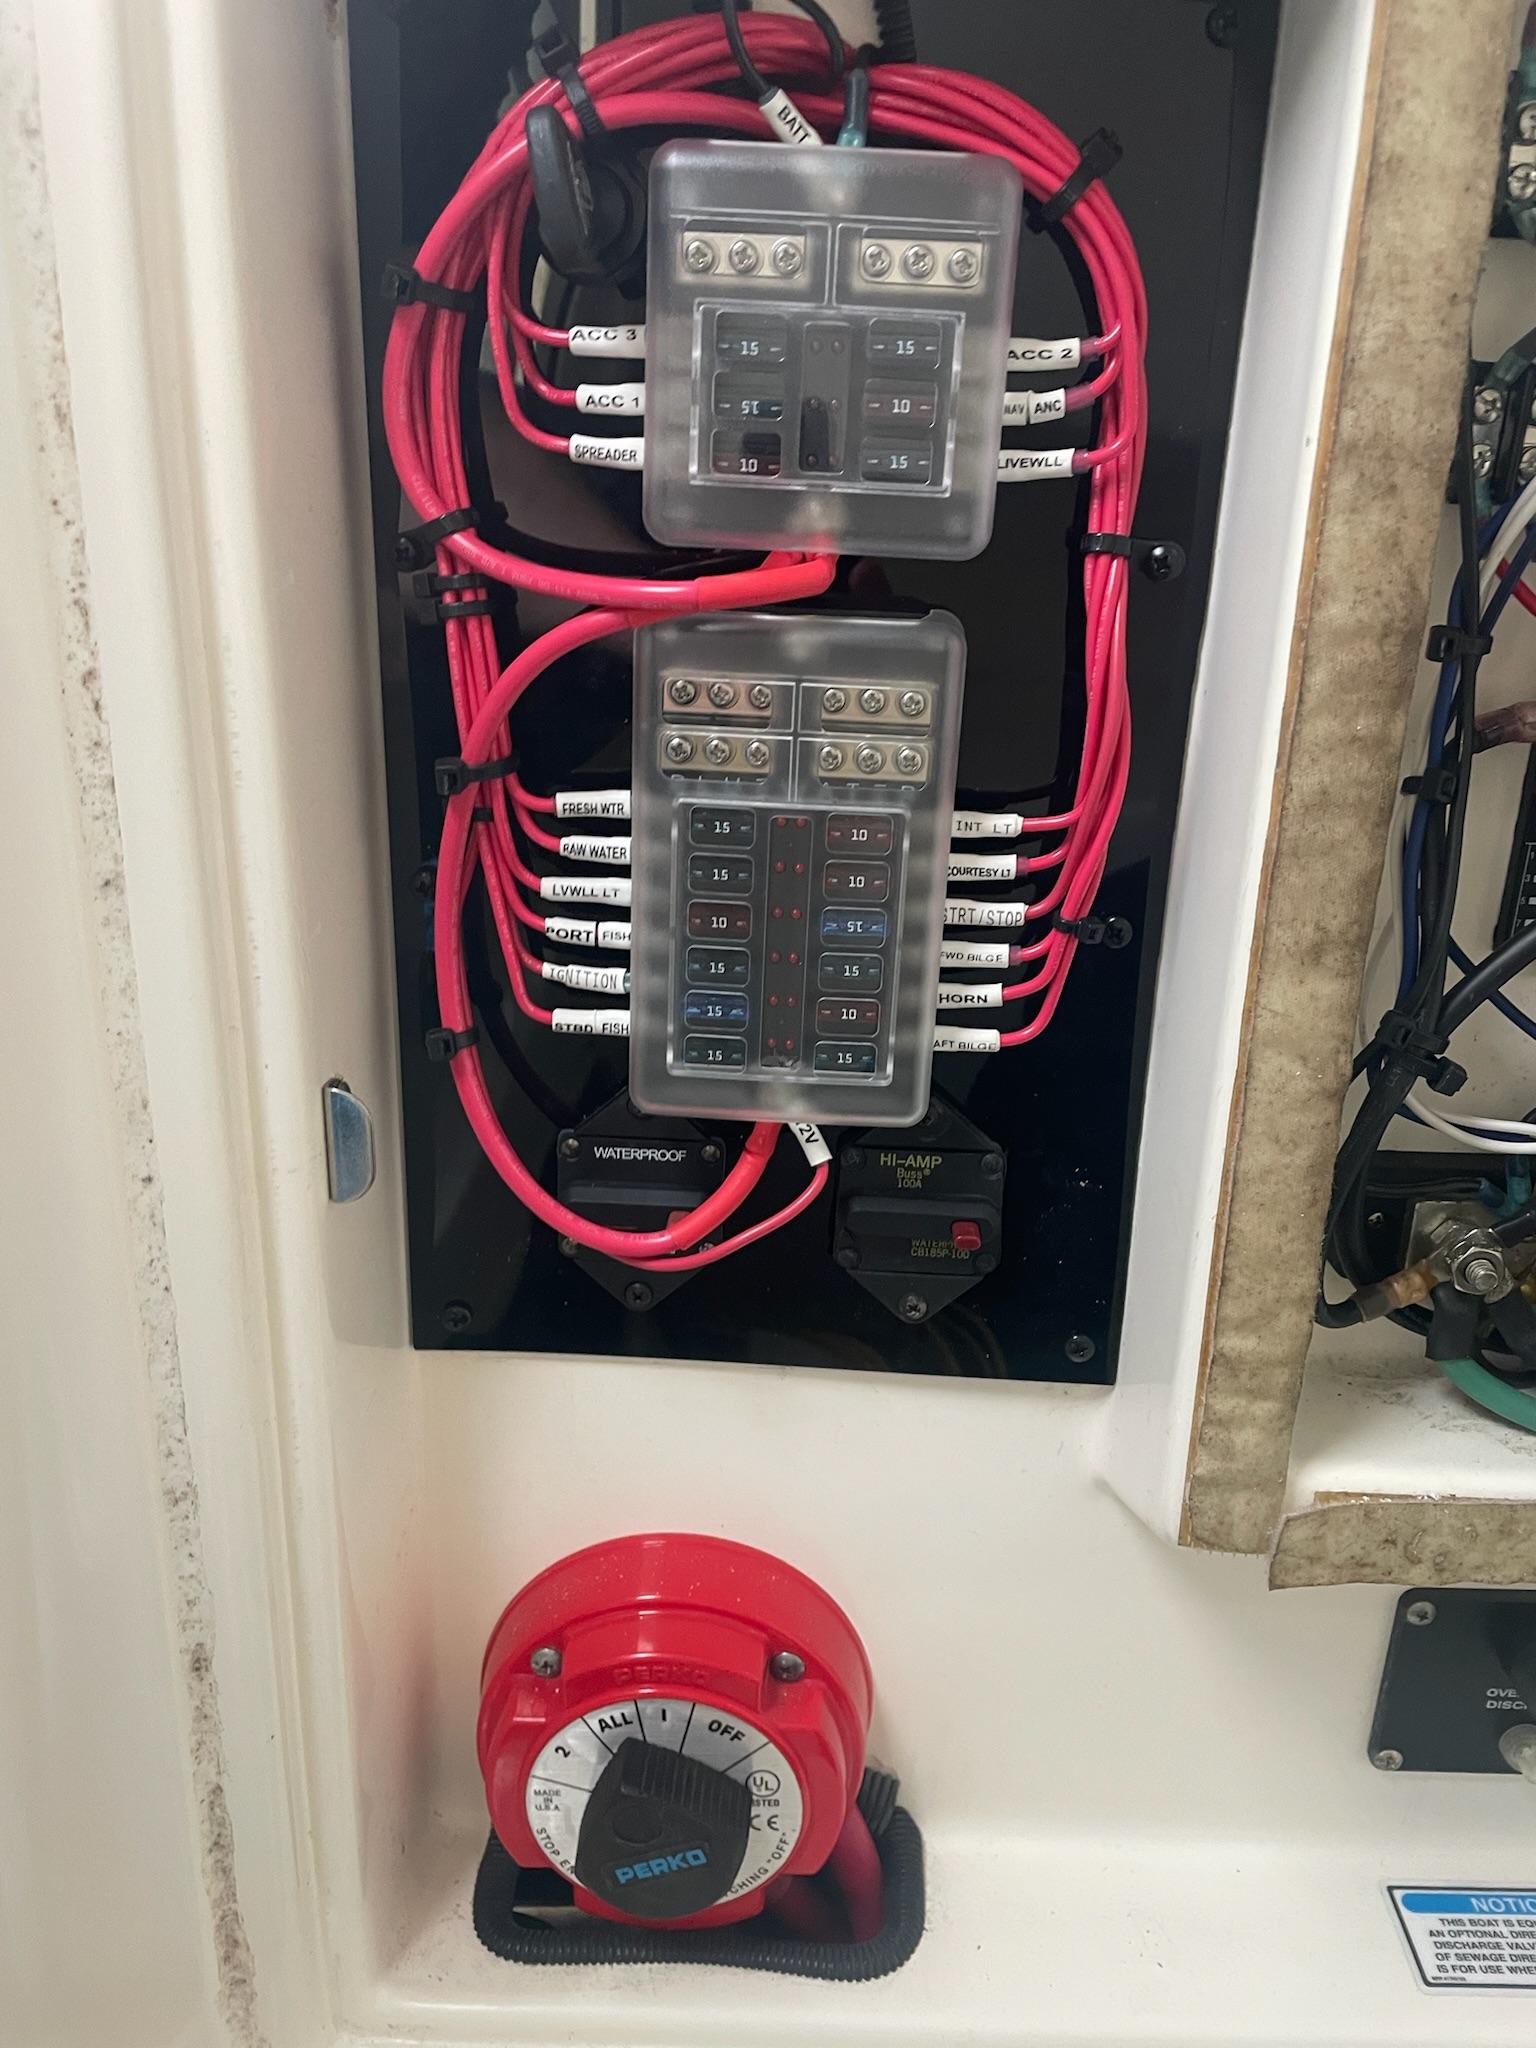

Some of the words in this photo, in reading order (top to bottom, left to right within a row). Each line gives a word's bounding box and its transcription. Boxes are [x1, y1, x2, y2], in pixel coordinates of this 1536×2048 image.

[777, 104, 812, 143] BATT
[571, 329, 619, 342] ACC
[626, 329, 637, 341] 3
[740, 341, 759, 355] 15
[896, 341, 914, 355] 15
[1007, 349, 1052, 360] ACC
[1060, 348, 1073, 359] 2
[585, 395, 624, 408] ACC
[633, 397, 640, 408] 1
[892, 399, 910, 413] 10
[1034, 400, 1062, 414] ANC
[574, 444, 637, 462] SPREADER
[739, 459, 758, 473] 10
[889, 455, 908, 469] 15
[998, 456, 1063, 469] LIVEWLL
[562, 802, 598, 816] FRESH
[601, 803, 625, 816] WTR
[714, 821, 730, 833] 15
[956, 820, 982, 833] INT
[993, 823, 1012, 834] LT
[851, 829, 868, 841] 10
[563, 843, 589, 858] RAW
[590, 845, 627, 859] WATER
[713, 869, 729, 881] 15
[848, 876, 865, 888] 10
[552, 885, 597, 898] LVWLL
[603, 888, 620, 898] LT
[711, 917, 728, 929] 10
[546, 927, 594, 943] PORT
[602, 930, 631, 942] FISH
[710, 962, 725, 974] 15
[843, 965, 860, 977] 15
[550, 967, 617, 989] IGNITION
[939, 994, 988, 1004] HORN
[707, 1006, 722, 1017] 15
[841, 1009, 857, 1020] 10
[602, 1022, 629, 1035] FISH
[933, 1039, 955, 1048] AFT
[707, 1050, 722, 1061] 15
[837, 1053, 853, 1064] 15
[796, 1122, 819, 1143] 2V
[594, 1146, 686, 1162] WATERPROOF
[880, 1152, 942, 1169] HI-AMP
[898, 1178, 922, 1188] 100A
[598, 1711, 633, 1733] ALL
[708, 1719, 746, 1744] OFF
[555, 1745, 571, 1758] 2
[534, 1789, 561, 1797] MADE
[536, 1827, 560, 1856] STOP
[615, 1849, 707, 1884] PERKO
[1438, 1918, 1466, 1927] THIS
[1469, 1918, 1499, 1927] BOAT
[1504, 1919, 1514, 1928] IS
[1429, 1930, 1445, 1938] AN
[1448, 1930, 1508, 1939] OPTIONAL
[1433, 1941, 1503, 1950] DISCHARGE
[1435, 1953, 1452, 1961] OF
[1455, 1953, 1507, 1962] SEWAGE
[1437, 1965, 1449, 1973] IS
[1451, 1965, 1477, 1974] FOR
[1479, 1965, 1504, 1974] USE
